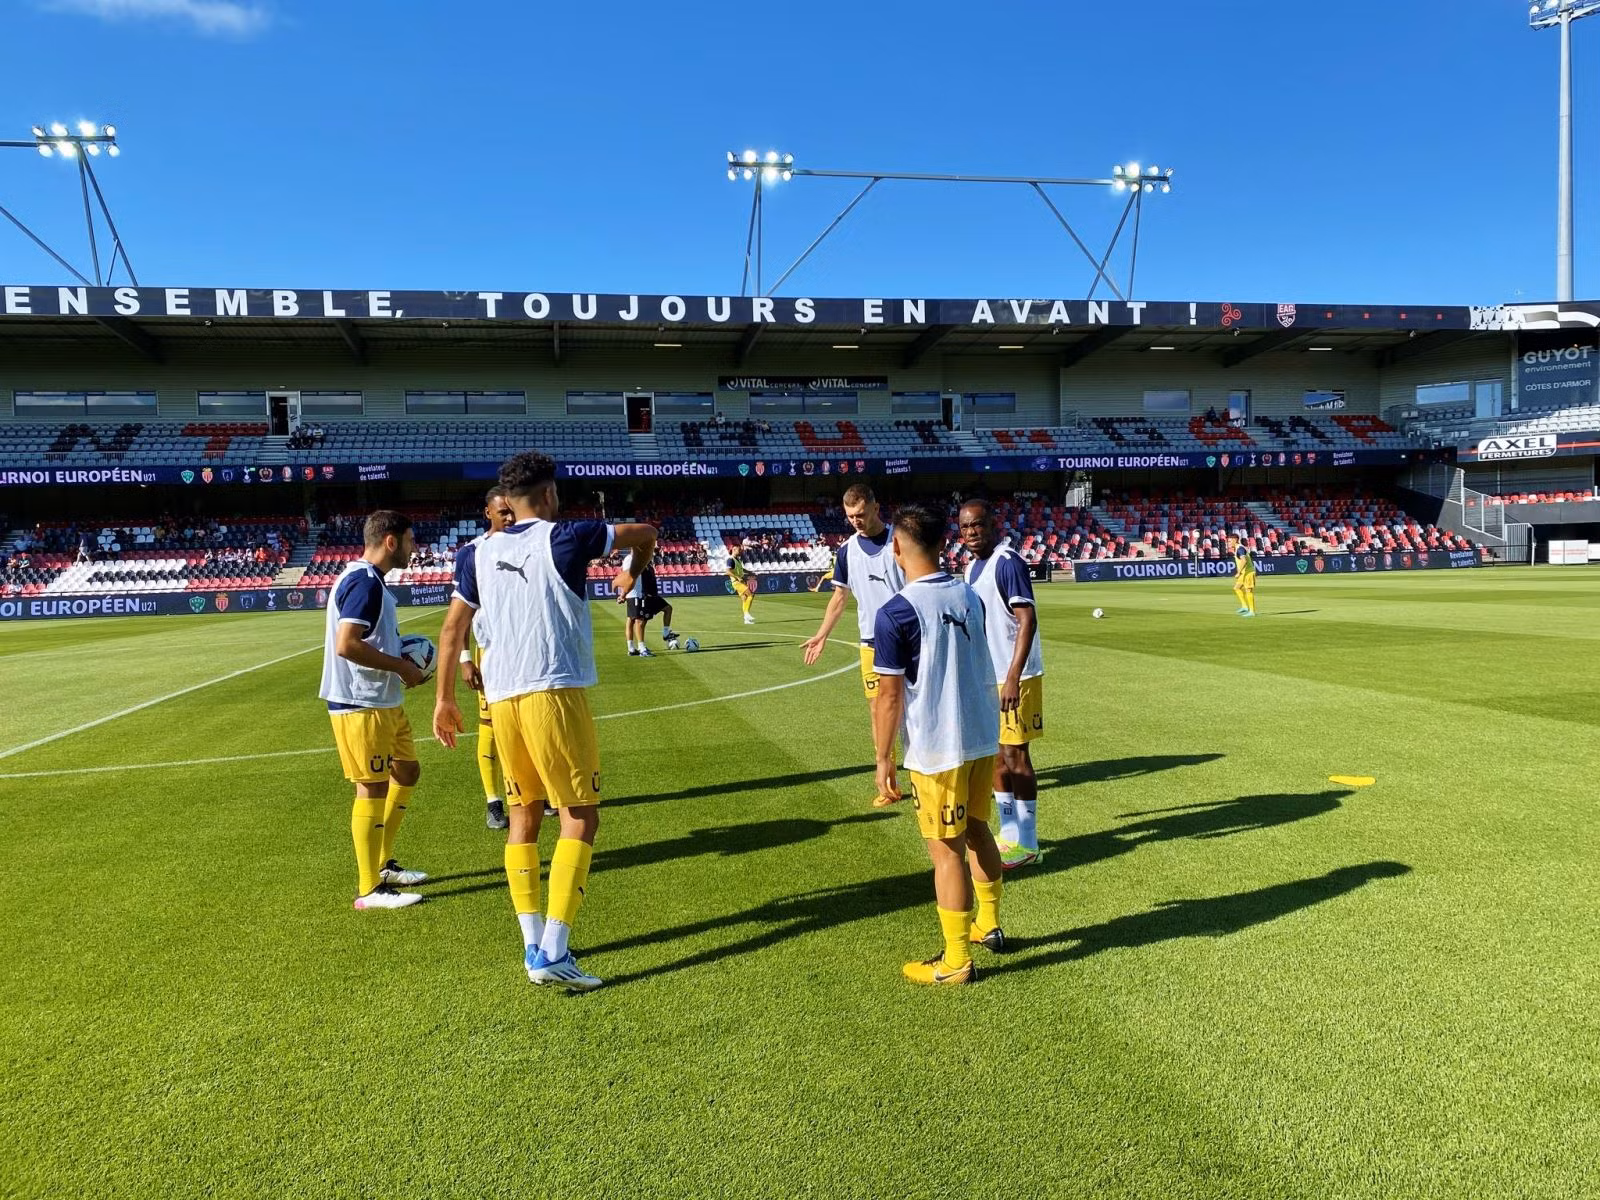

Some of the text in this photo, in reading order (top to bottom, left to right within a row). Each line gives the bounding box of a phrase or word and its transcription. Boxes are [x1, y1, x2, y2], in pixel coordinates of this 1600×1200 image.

[4, 286, 403, 318] ENSEMBLE,
[478, 292, 816, 324] TOUJOURS
[863, 298, 926, 324] EN
[971, 299, 1147, 325] AVANT
[1523, 345, 1593, 365] GUYOT
[1524, 360, 1592, 374] environnement
[1553, 379, 1592, 390] D'ARMOR
[1483, 436, 1553, 451] AXEL
[1058, 457, 1114, 469] TOURNOI
[1117, 454, 1179, 468] EUROPÉEN
[1481, 448, 1553, 460] FERMETURES
[55, 467, 143, 483] EUROPÉEN
[143, 473, 156, 482] U21
[565, 464, 631, 477] TOURNOI
[635, 462, 707, 476] EUROPÉEN
[1113, 560, 1275, 578] TOURNOI EUROPN U21
[686, 583, 699, 593] U21
[30, 596, 140, 616] EUROPÉEN
[141, 601, 157, 612] U21
[411, 597, 420, 605] de
[421, 594, 445, 605] talents
